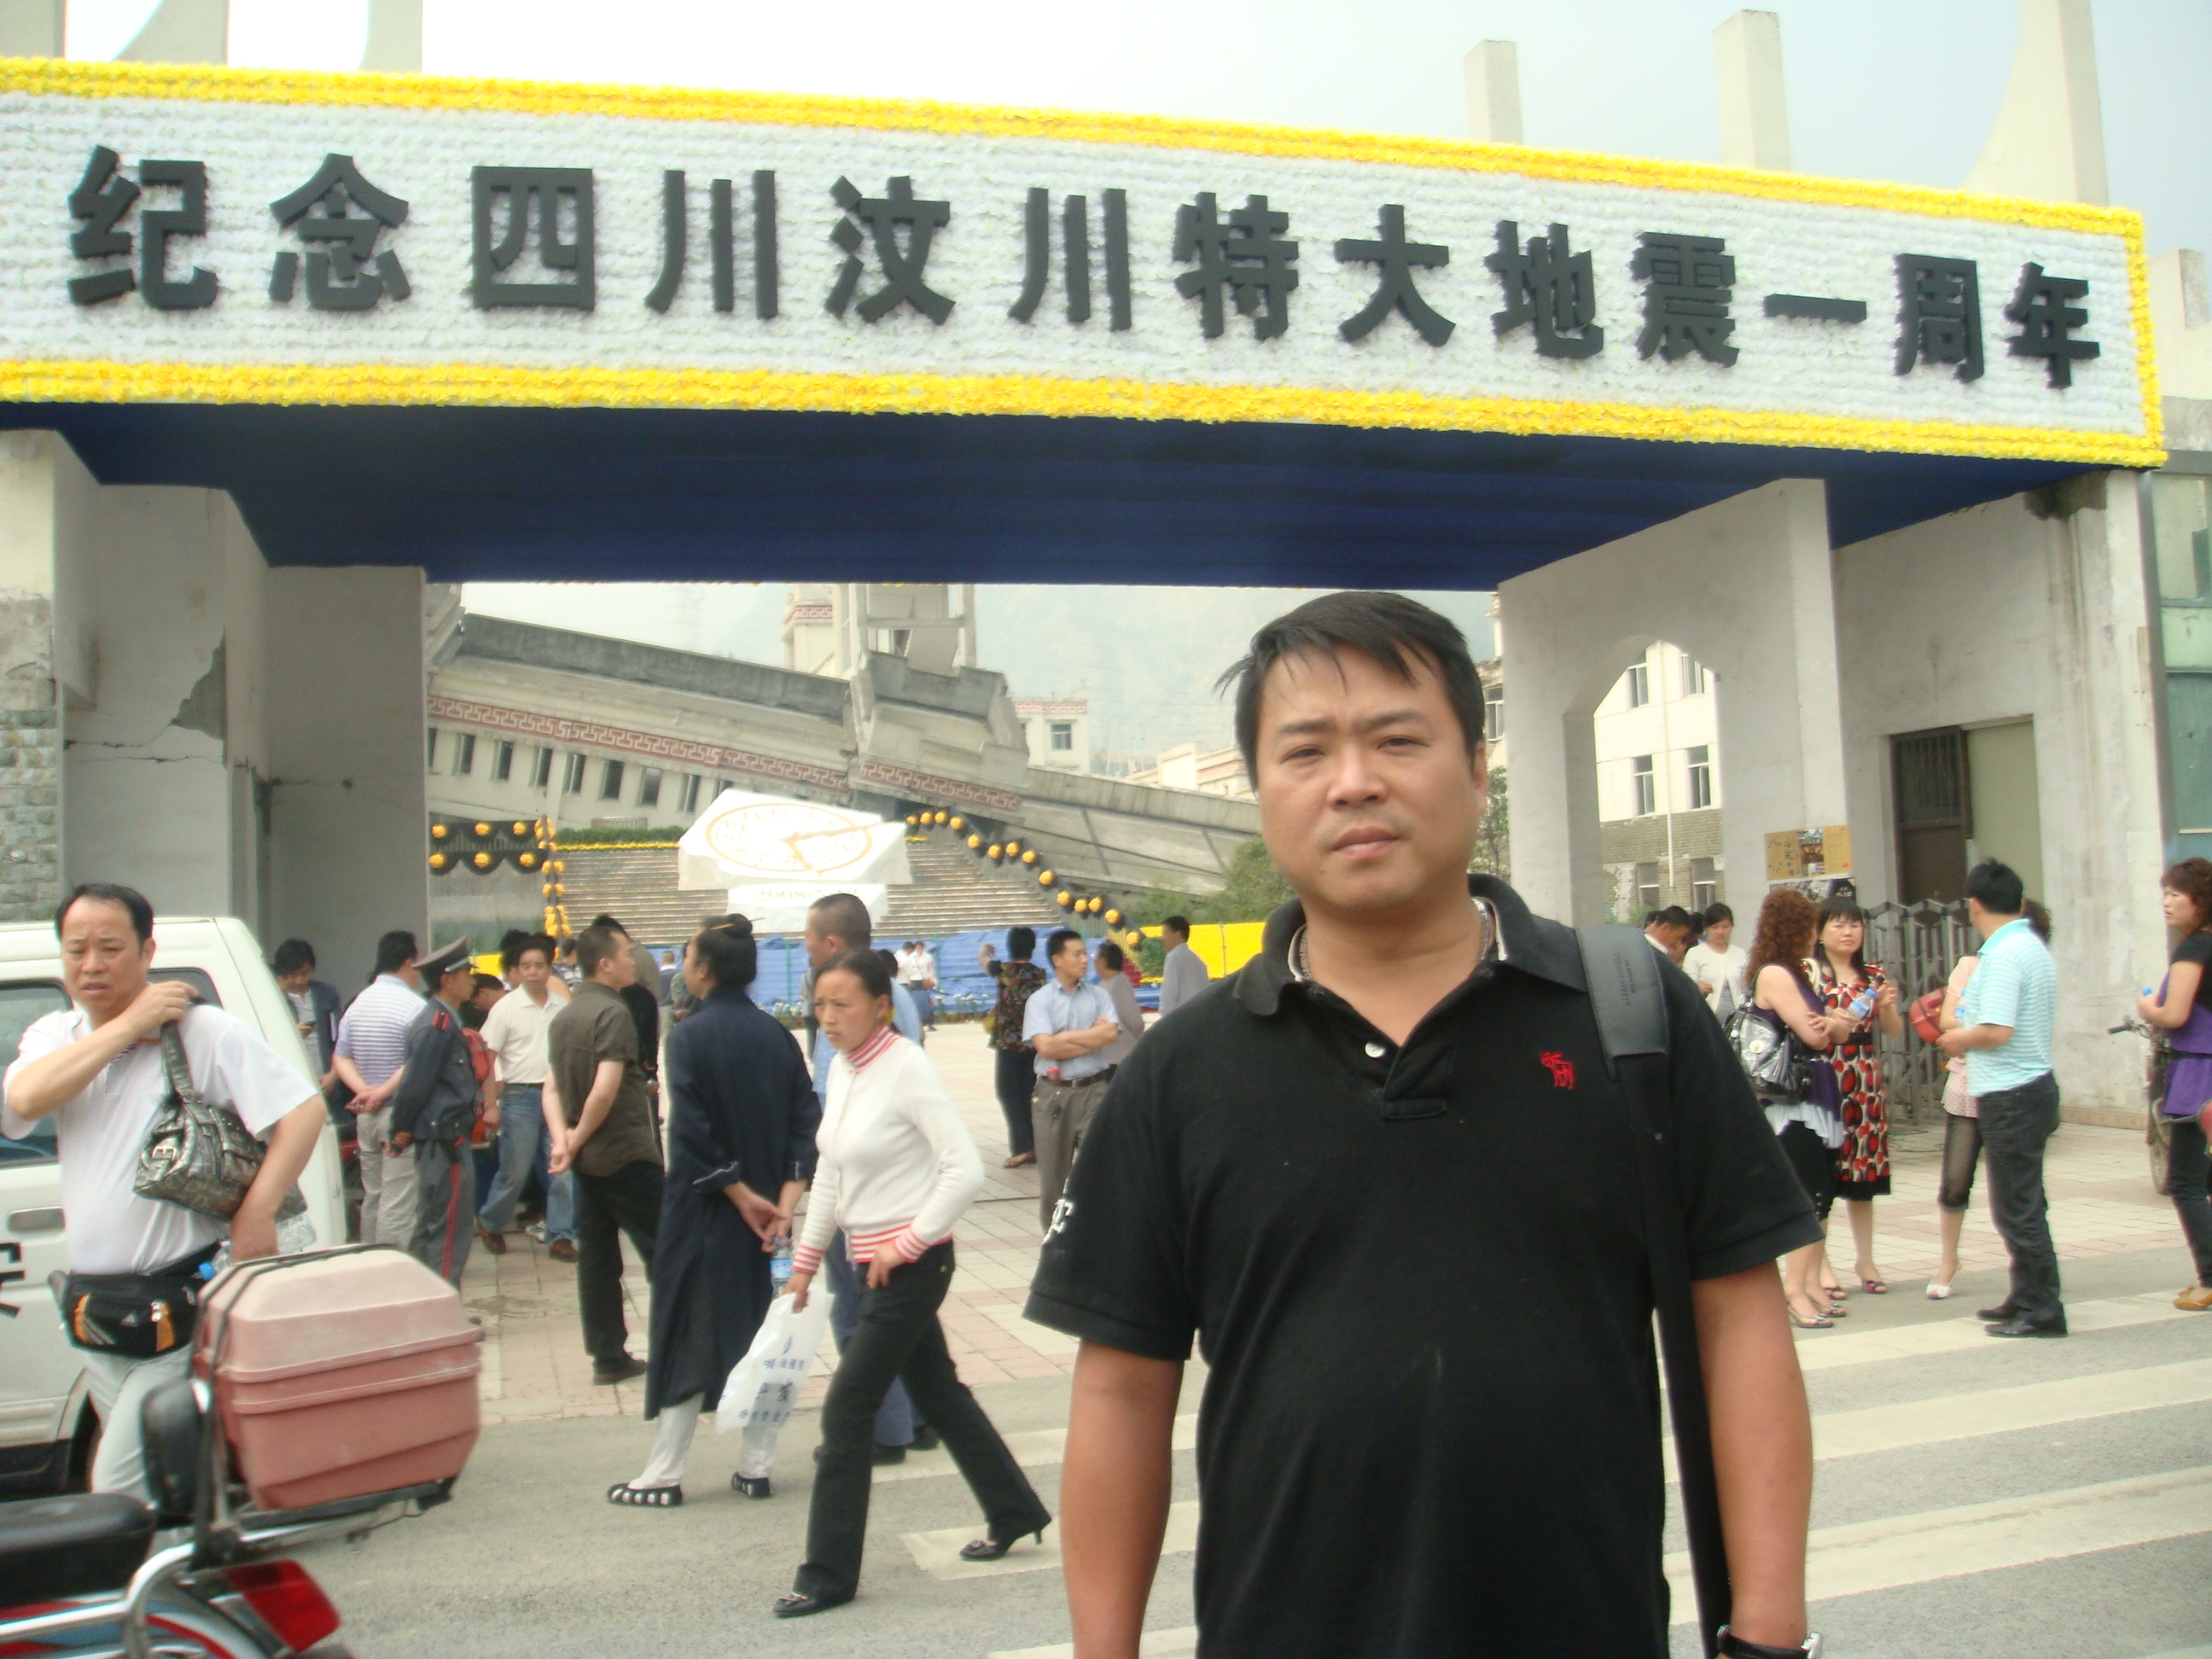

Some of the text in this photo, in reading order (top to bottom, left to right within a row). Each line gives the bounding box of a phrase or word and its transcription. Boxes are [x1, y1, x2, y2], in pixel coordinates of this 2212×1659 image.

[67, 145, 2100, 389] 纪念四川汶川特大地震一周年
